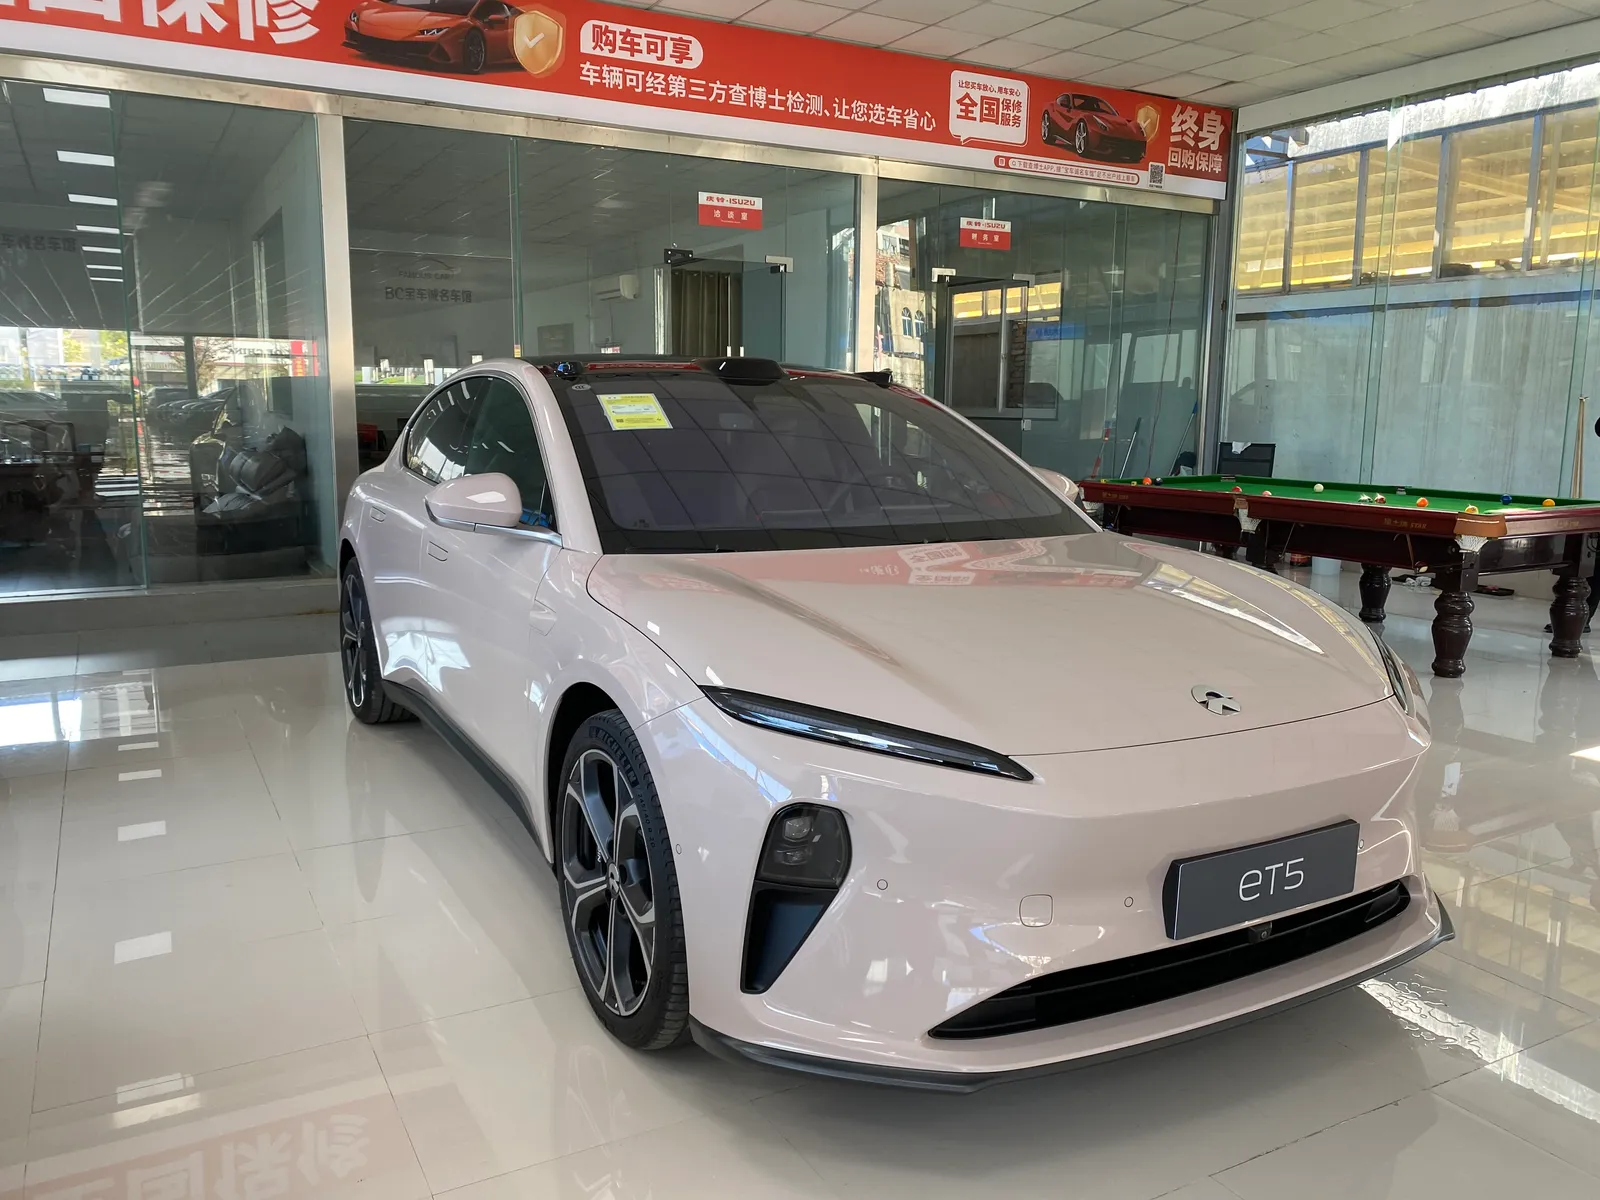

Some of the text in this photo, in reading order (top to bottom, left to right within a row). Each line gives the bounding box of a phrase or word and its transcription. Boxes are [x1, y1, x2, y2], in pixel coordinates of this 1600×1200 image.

[591, 23, 693, 65] 购车可享
[956, 91, 1000, 125] 全国
[1001, 112, 1022, 128] 服务
[1170, 103, 1225, 151] 终身
[1167, 146, 1223, 174] 回购保障
[593, 725, 639, 787] MICHELIN
